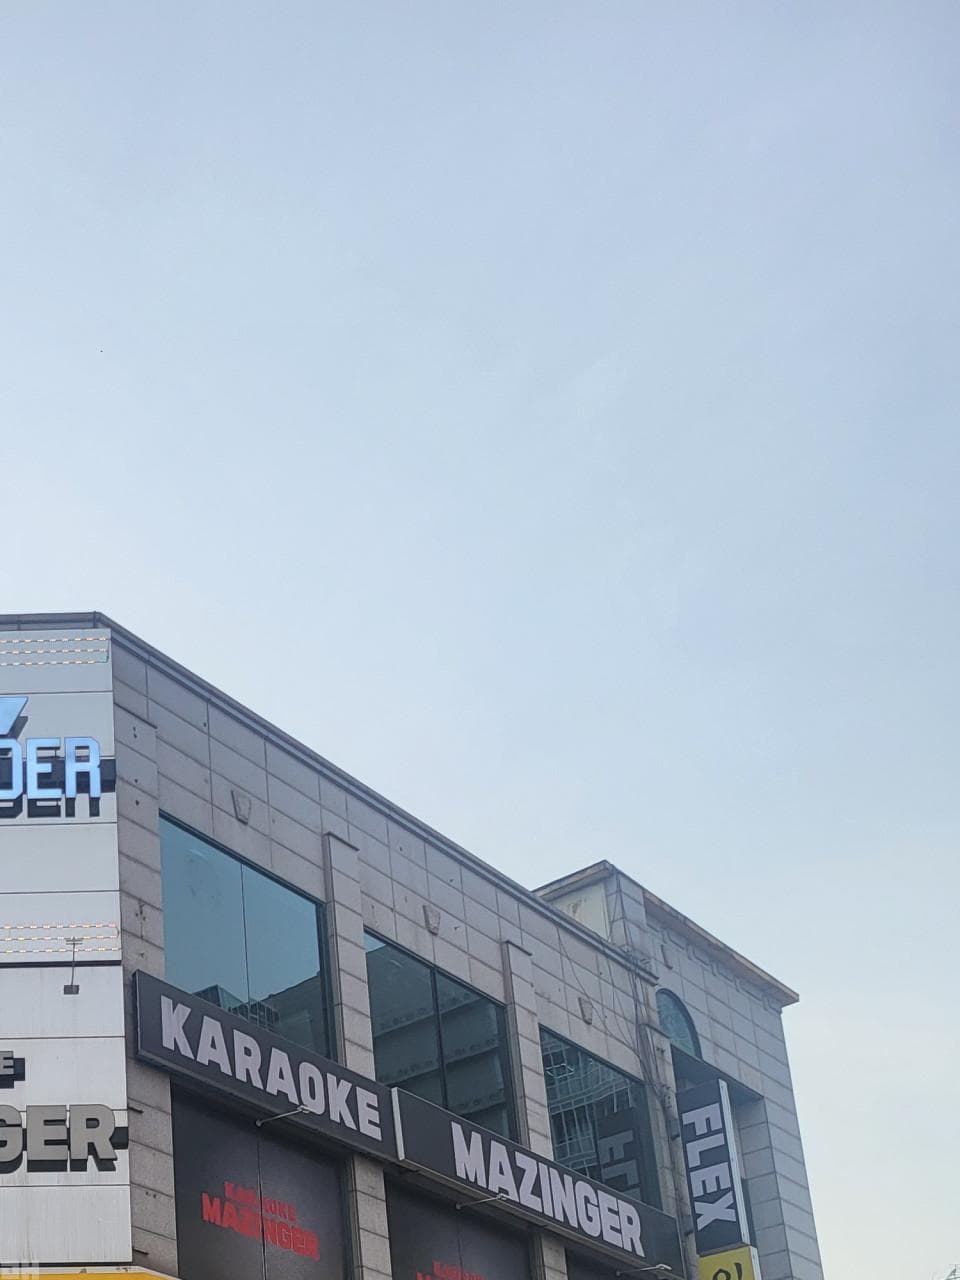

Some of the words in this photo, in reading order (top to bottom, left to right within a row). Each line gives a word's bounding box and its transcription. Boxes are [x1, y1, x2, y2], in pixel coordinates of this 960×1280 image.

[160, 995, 383, 1142] KARAOKE
[451, 1122, 646, 1258] MAZINGER
[682, 1102, 737, 1233] FLEX
